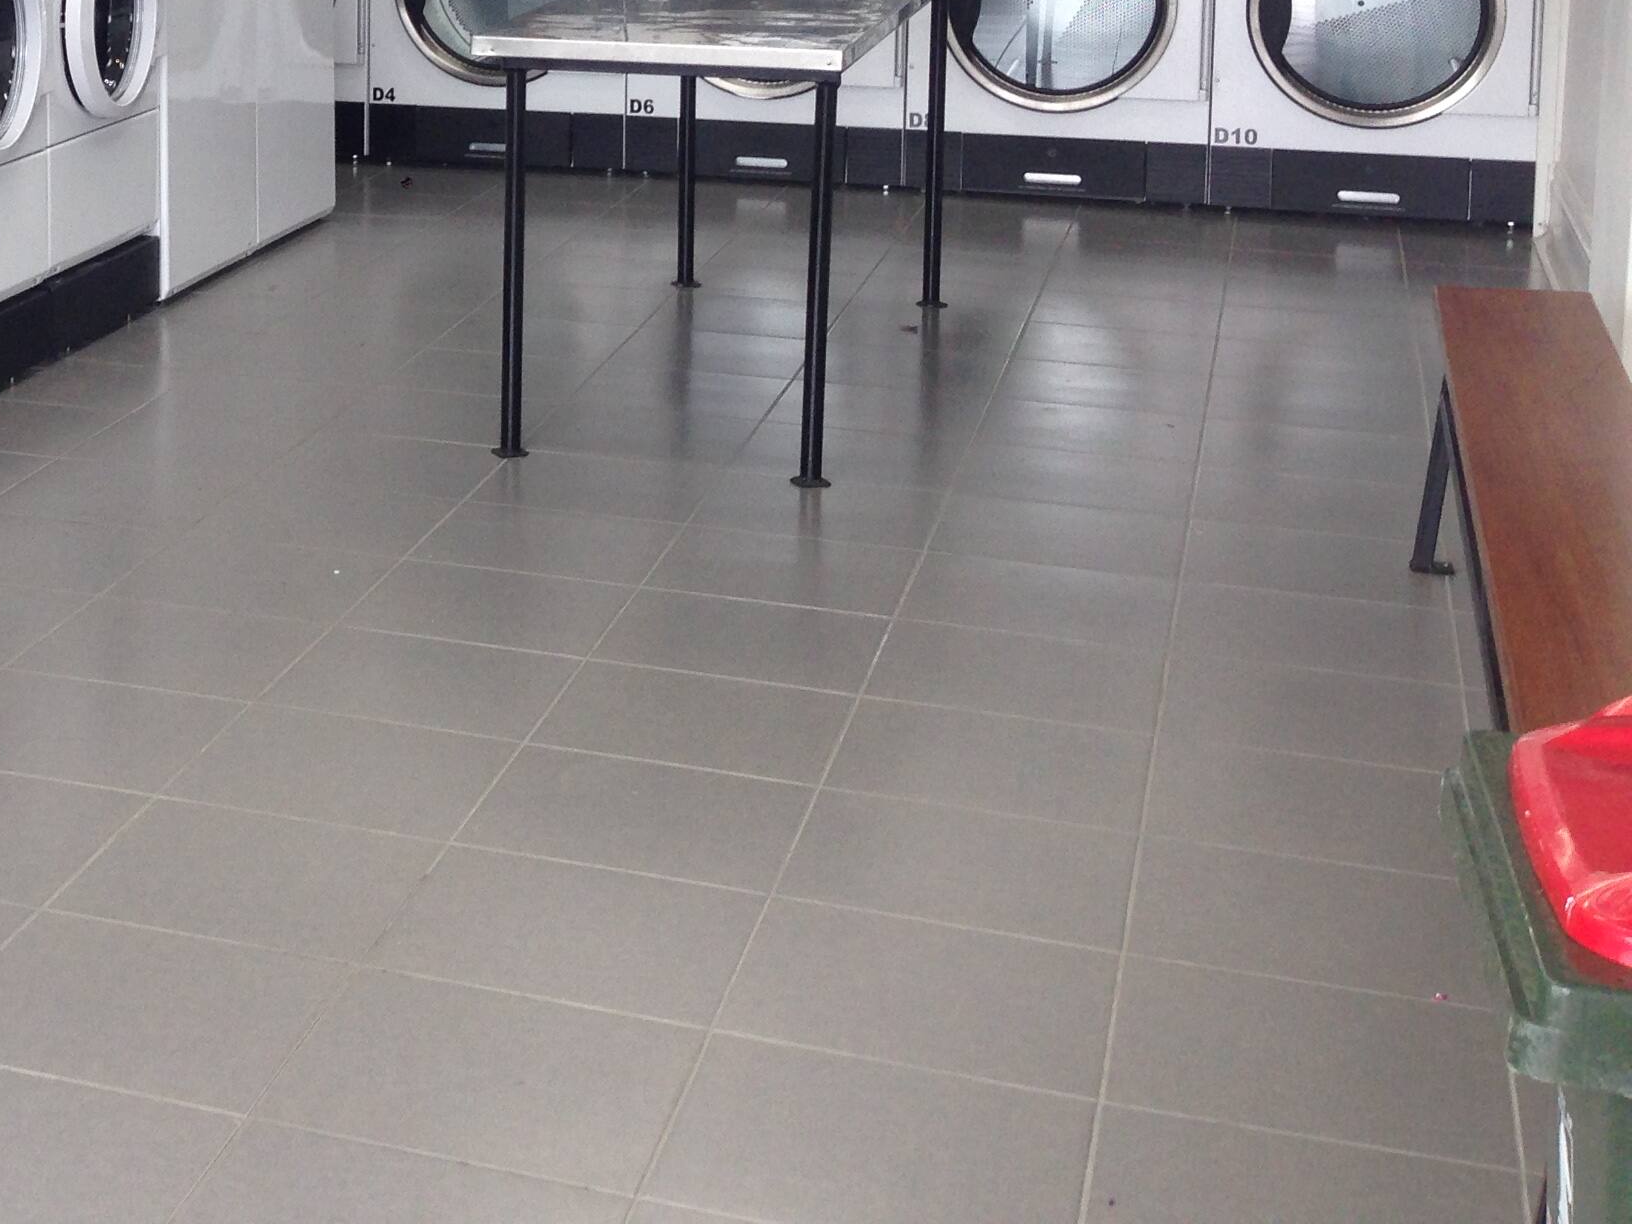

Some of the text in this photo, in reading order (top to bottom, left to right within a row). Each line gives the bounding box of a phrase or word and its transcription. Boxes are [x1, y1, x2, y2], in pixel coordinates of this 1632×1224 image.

[372, 87, 396, 102] D4
[629, 99, 655, 115] D6
[909, 112, 929, 128] D
[1214, 128, 1258, 146] D10
